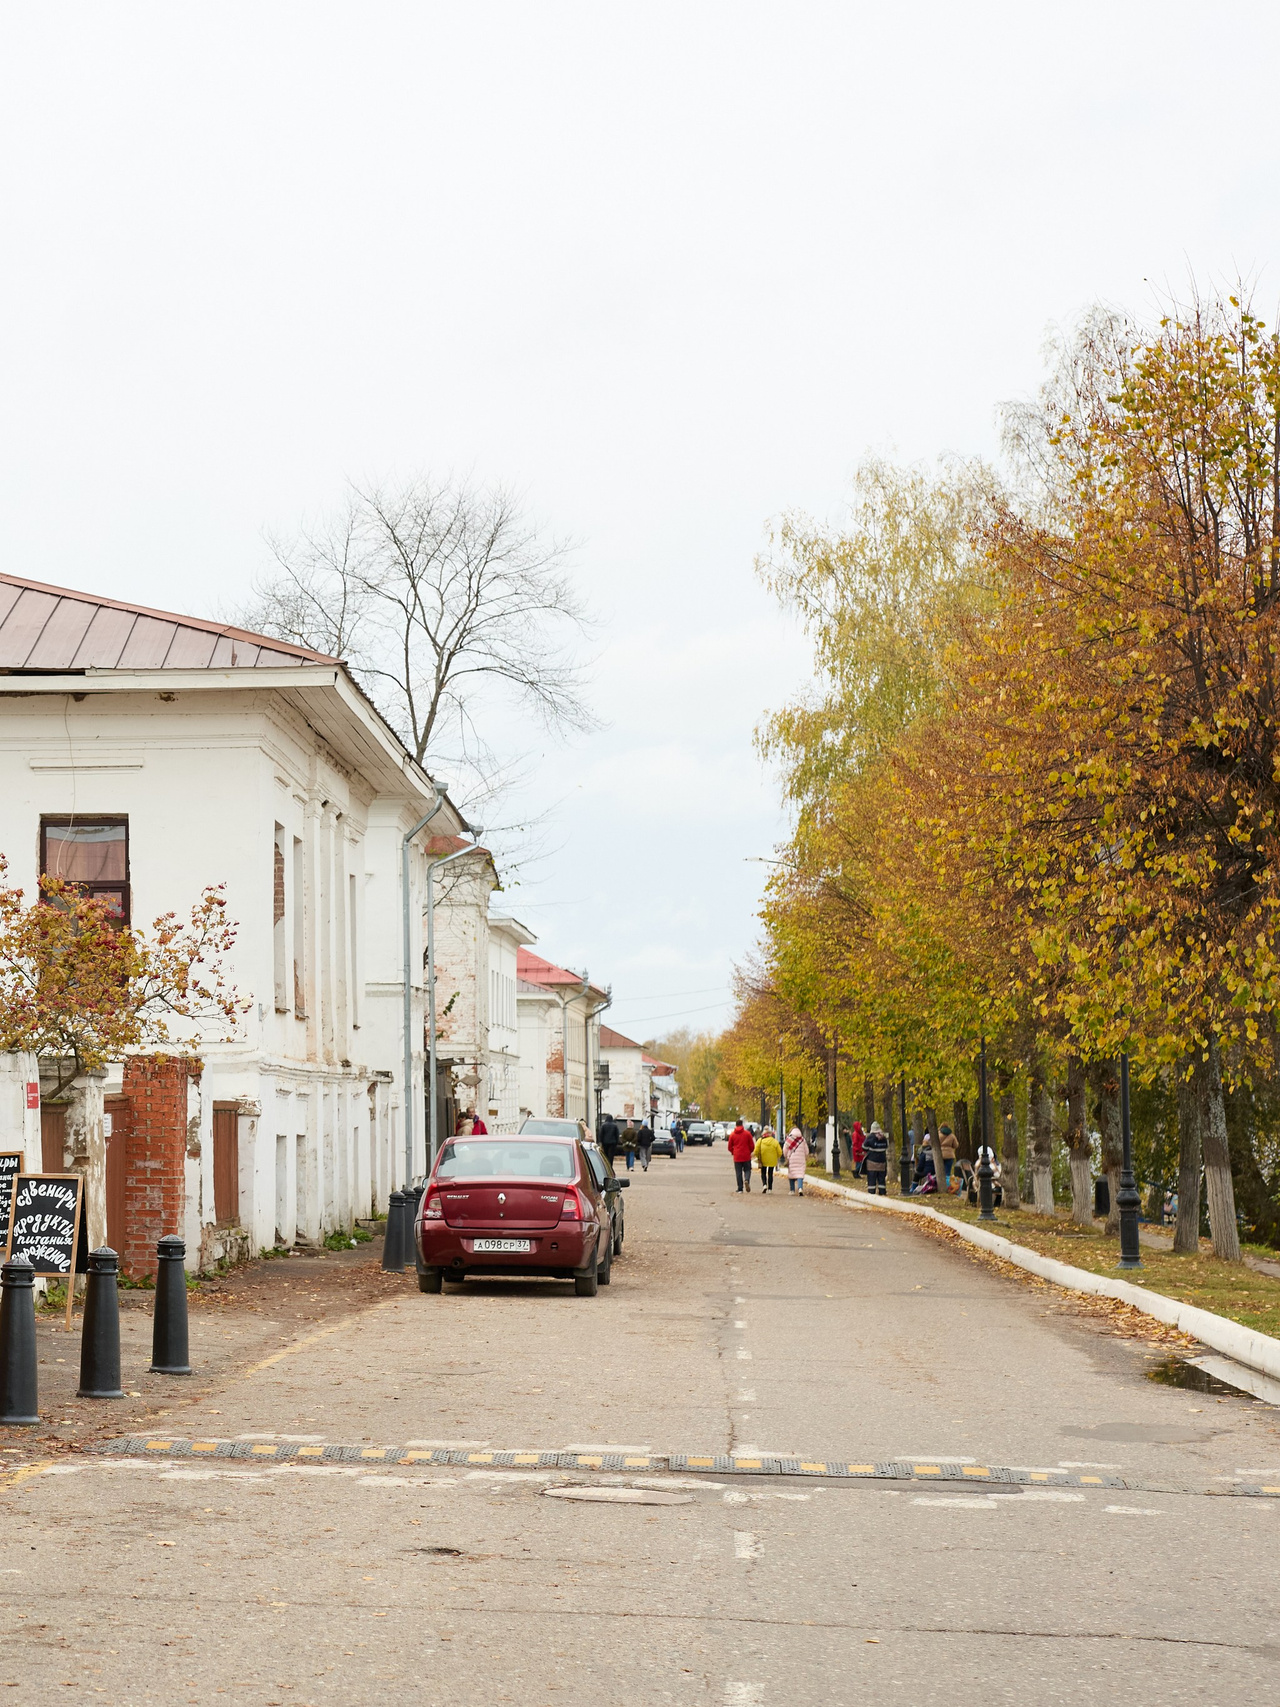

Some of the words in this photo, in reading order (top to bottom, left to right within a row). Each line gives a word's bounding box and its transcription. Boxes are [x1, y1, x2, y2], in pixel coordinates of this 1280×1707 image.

[16, 1180, 77, 1210] сувениры
[13, 1213, 74, 1237] продукты
[17, 1235, 73, 1245] питания
